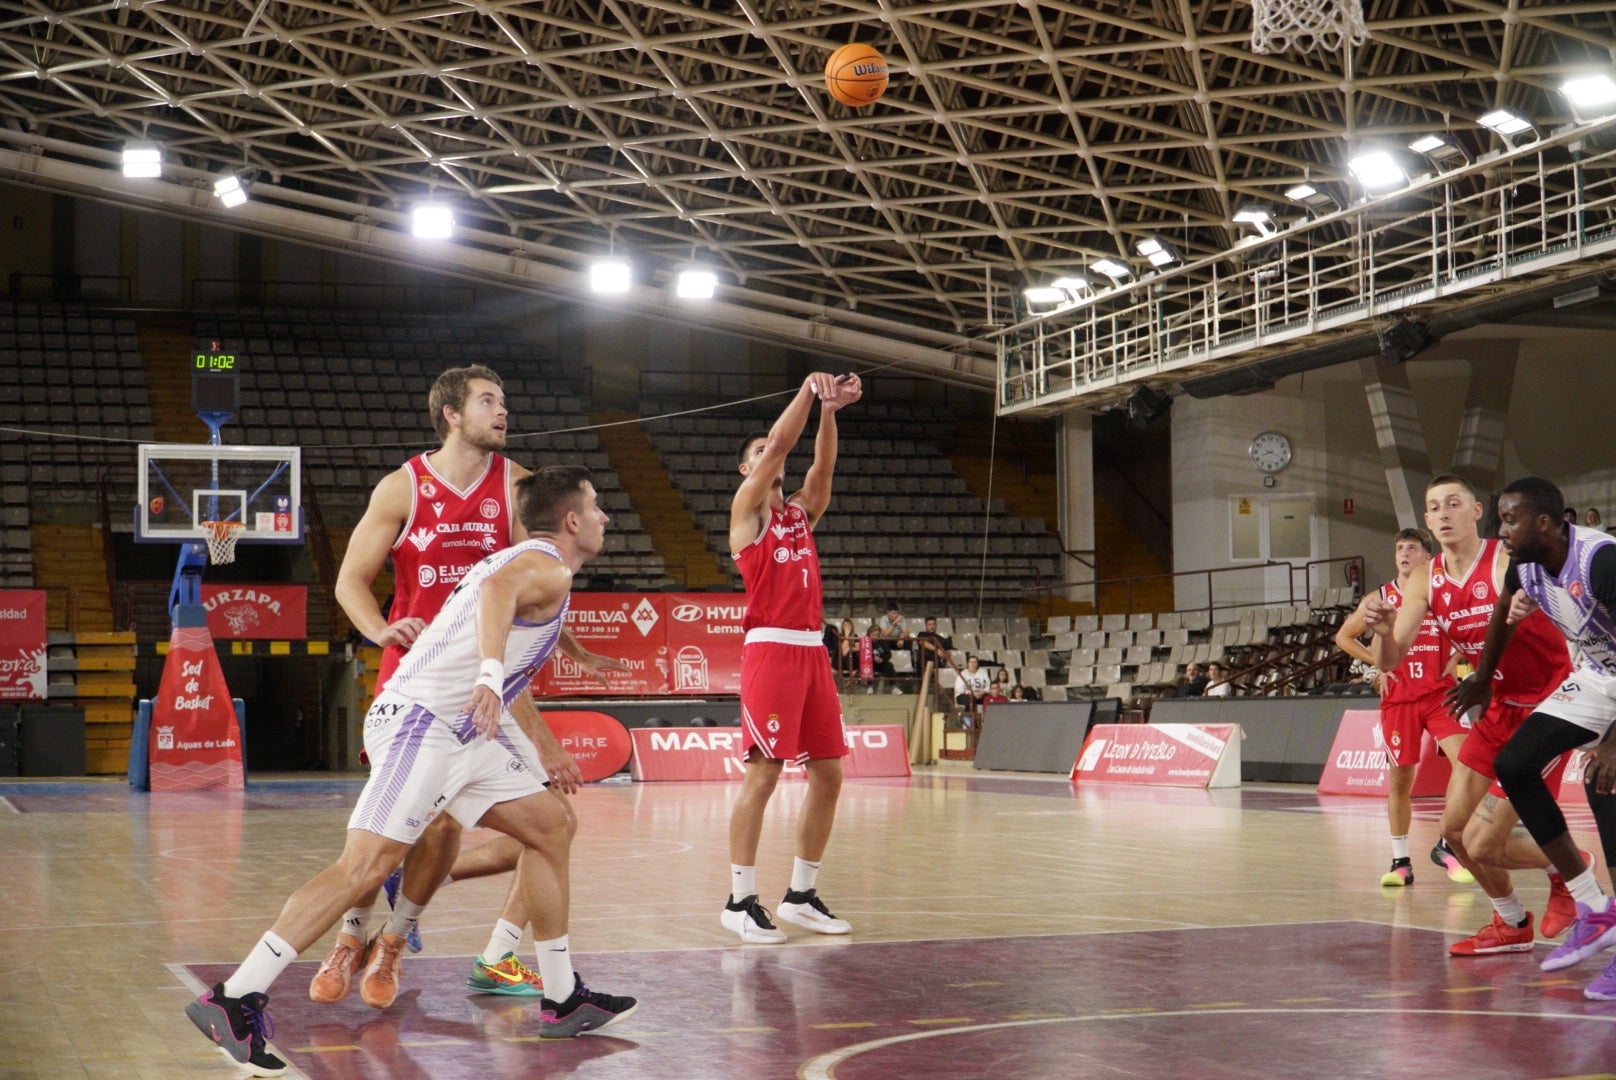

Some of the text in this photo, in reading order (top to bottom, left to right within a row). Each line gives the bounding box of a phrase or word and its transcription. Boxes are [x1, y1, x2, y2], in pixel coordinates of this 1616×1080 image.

[853, 63, 887, 77] Wils
[196, 355, 235, 369] 01:02
[461, 522, 497, 533] RURAL
[202, 589, 281, 613] URZAPA
[564, 611, 629, 623] TILVA
[181, 660, 203, 677] Sed
[1408, 662, 1423, 679] 13
[185, 677, 199, 694] de
[175, 694, 215, 710] Basket
[177, 741, 202, 750] Aguas
[204, 740, 215, 749] de
[1336, 750, 1366, 769] CAJA
